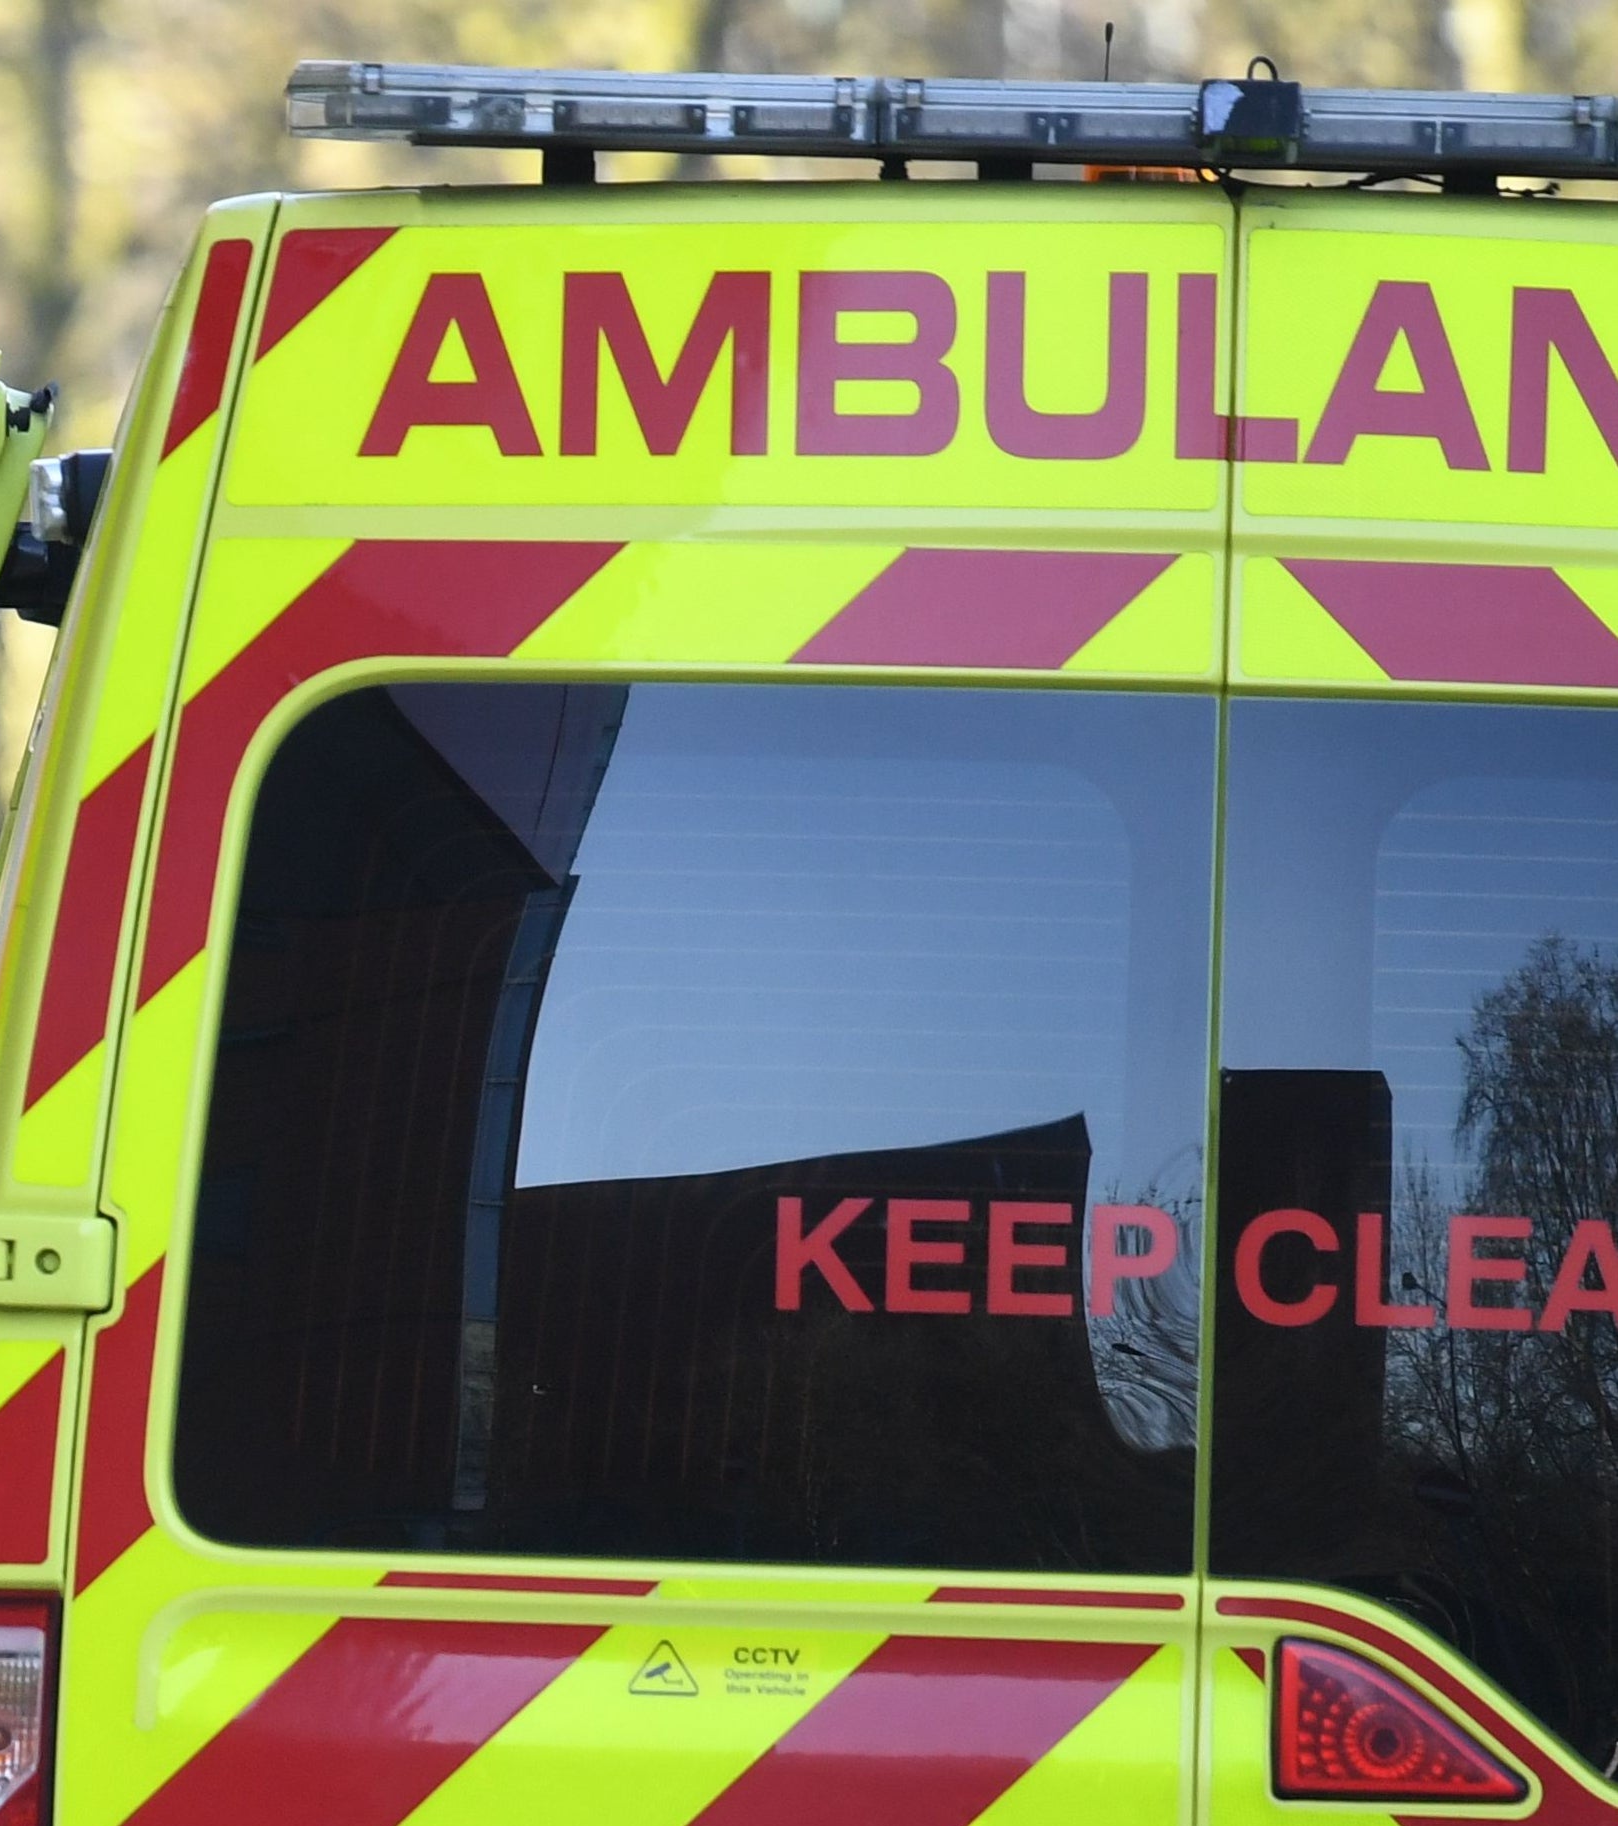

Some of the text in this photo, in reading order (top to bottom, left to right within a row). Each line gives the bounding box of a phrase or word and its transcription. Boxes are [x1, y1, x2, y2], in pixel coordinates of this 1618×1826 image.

[356, 270, 1618, 474] AMBULAN
[774, 1196, 1618, 1333] KEEP CLEA
[734, 1647, 801, 1665] CCTV
[725, 1669, 810, 1682] Operating in
[726, 1684, 807, 1696] this Vehicle
